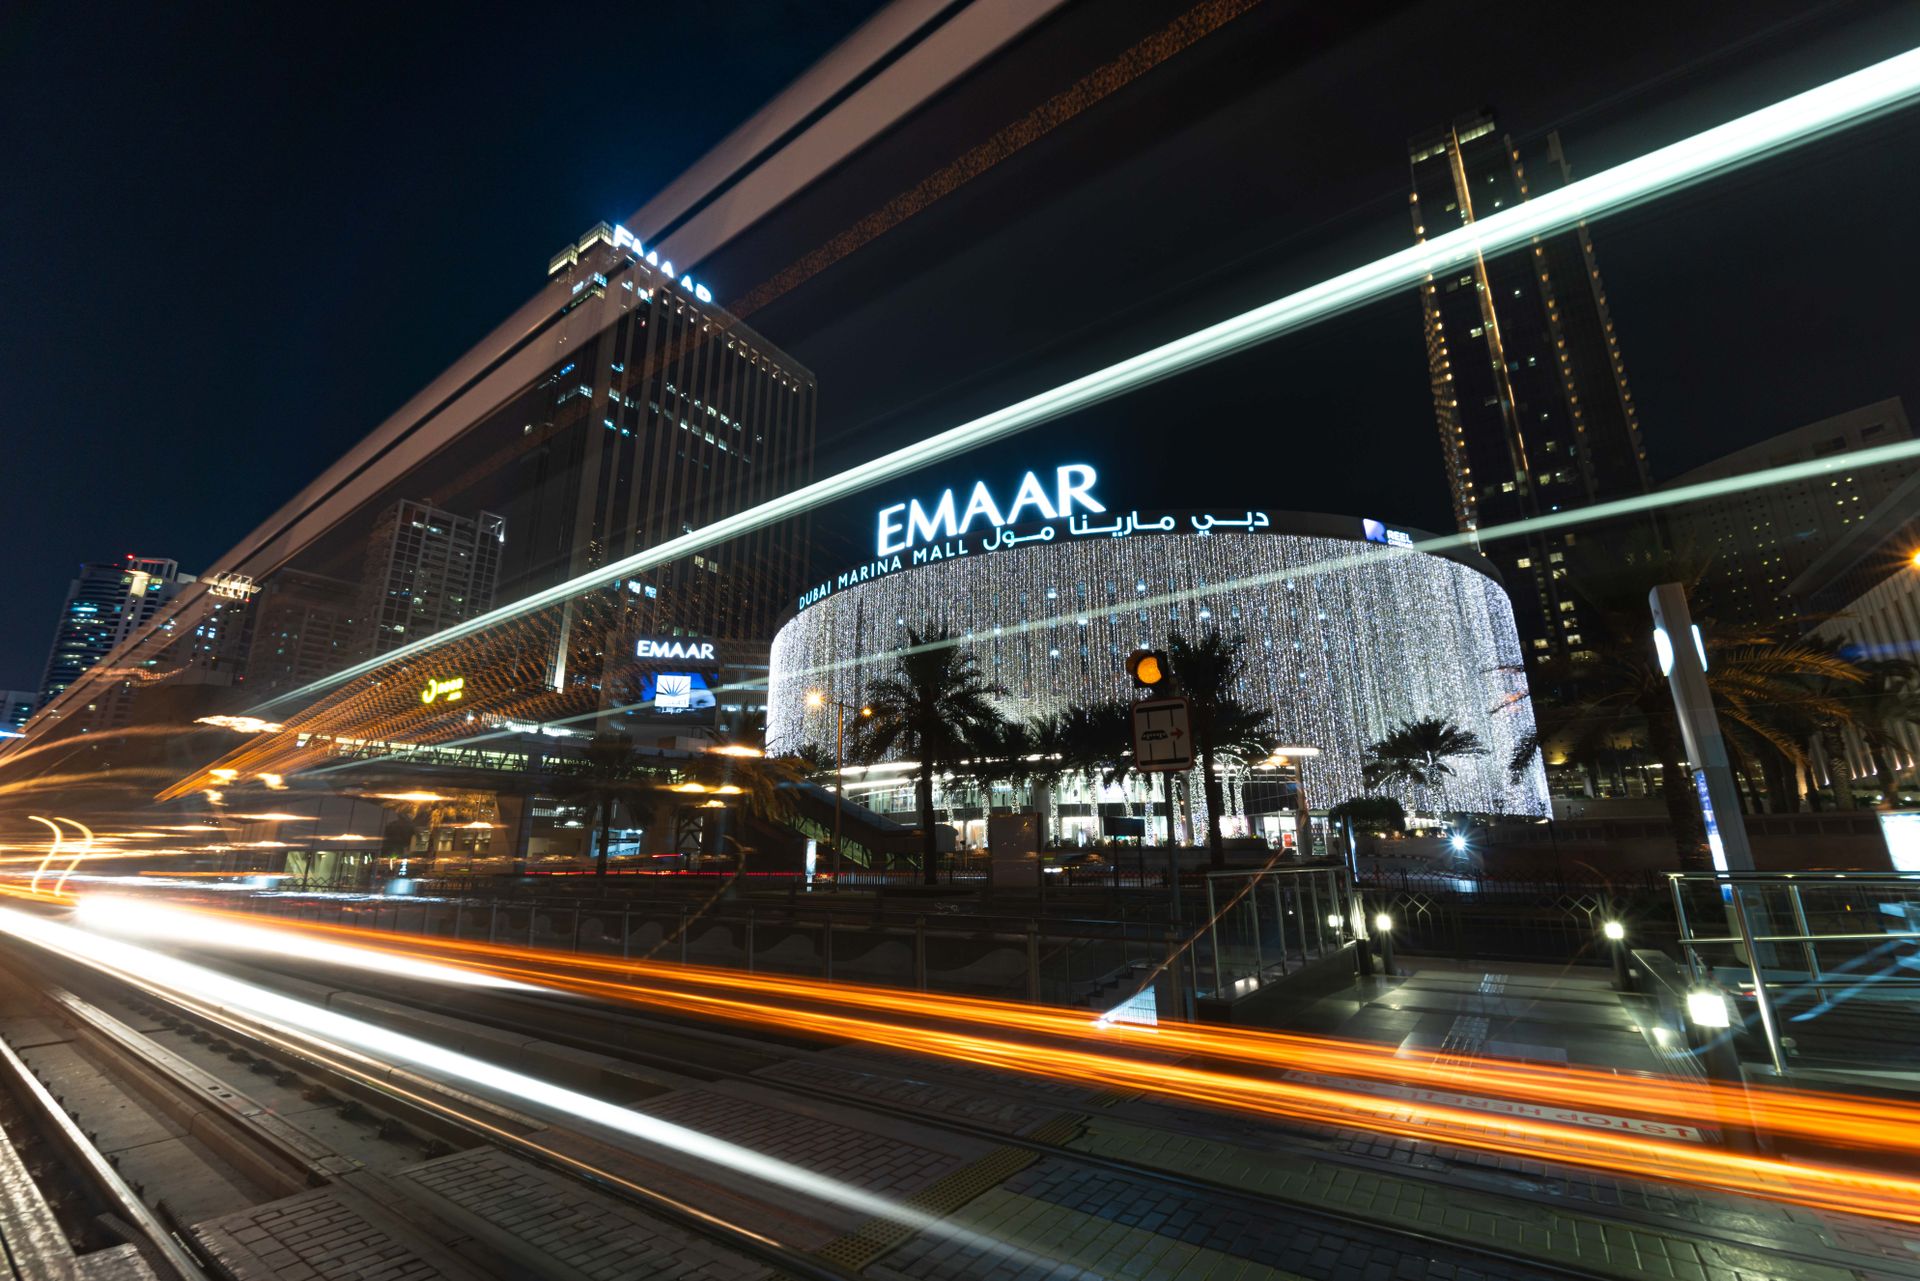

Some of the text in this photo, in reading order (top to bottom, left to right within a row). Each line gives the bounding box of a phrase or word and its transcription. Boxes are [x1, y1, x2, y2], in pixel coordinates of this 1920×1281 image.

[877, 463, 1106, 558] EMAAR
[983, 510, 1270, 551] دبي مارينا مول
[799, 540, 968, 611] DUBAI MARINA MALL
[636, 639, 714, 660] EMAAR
